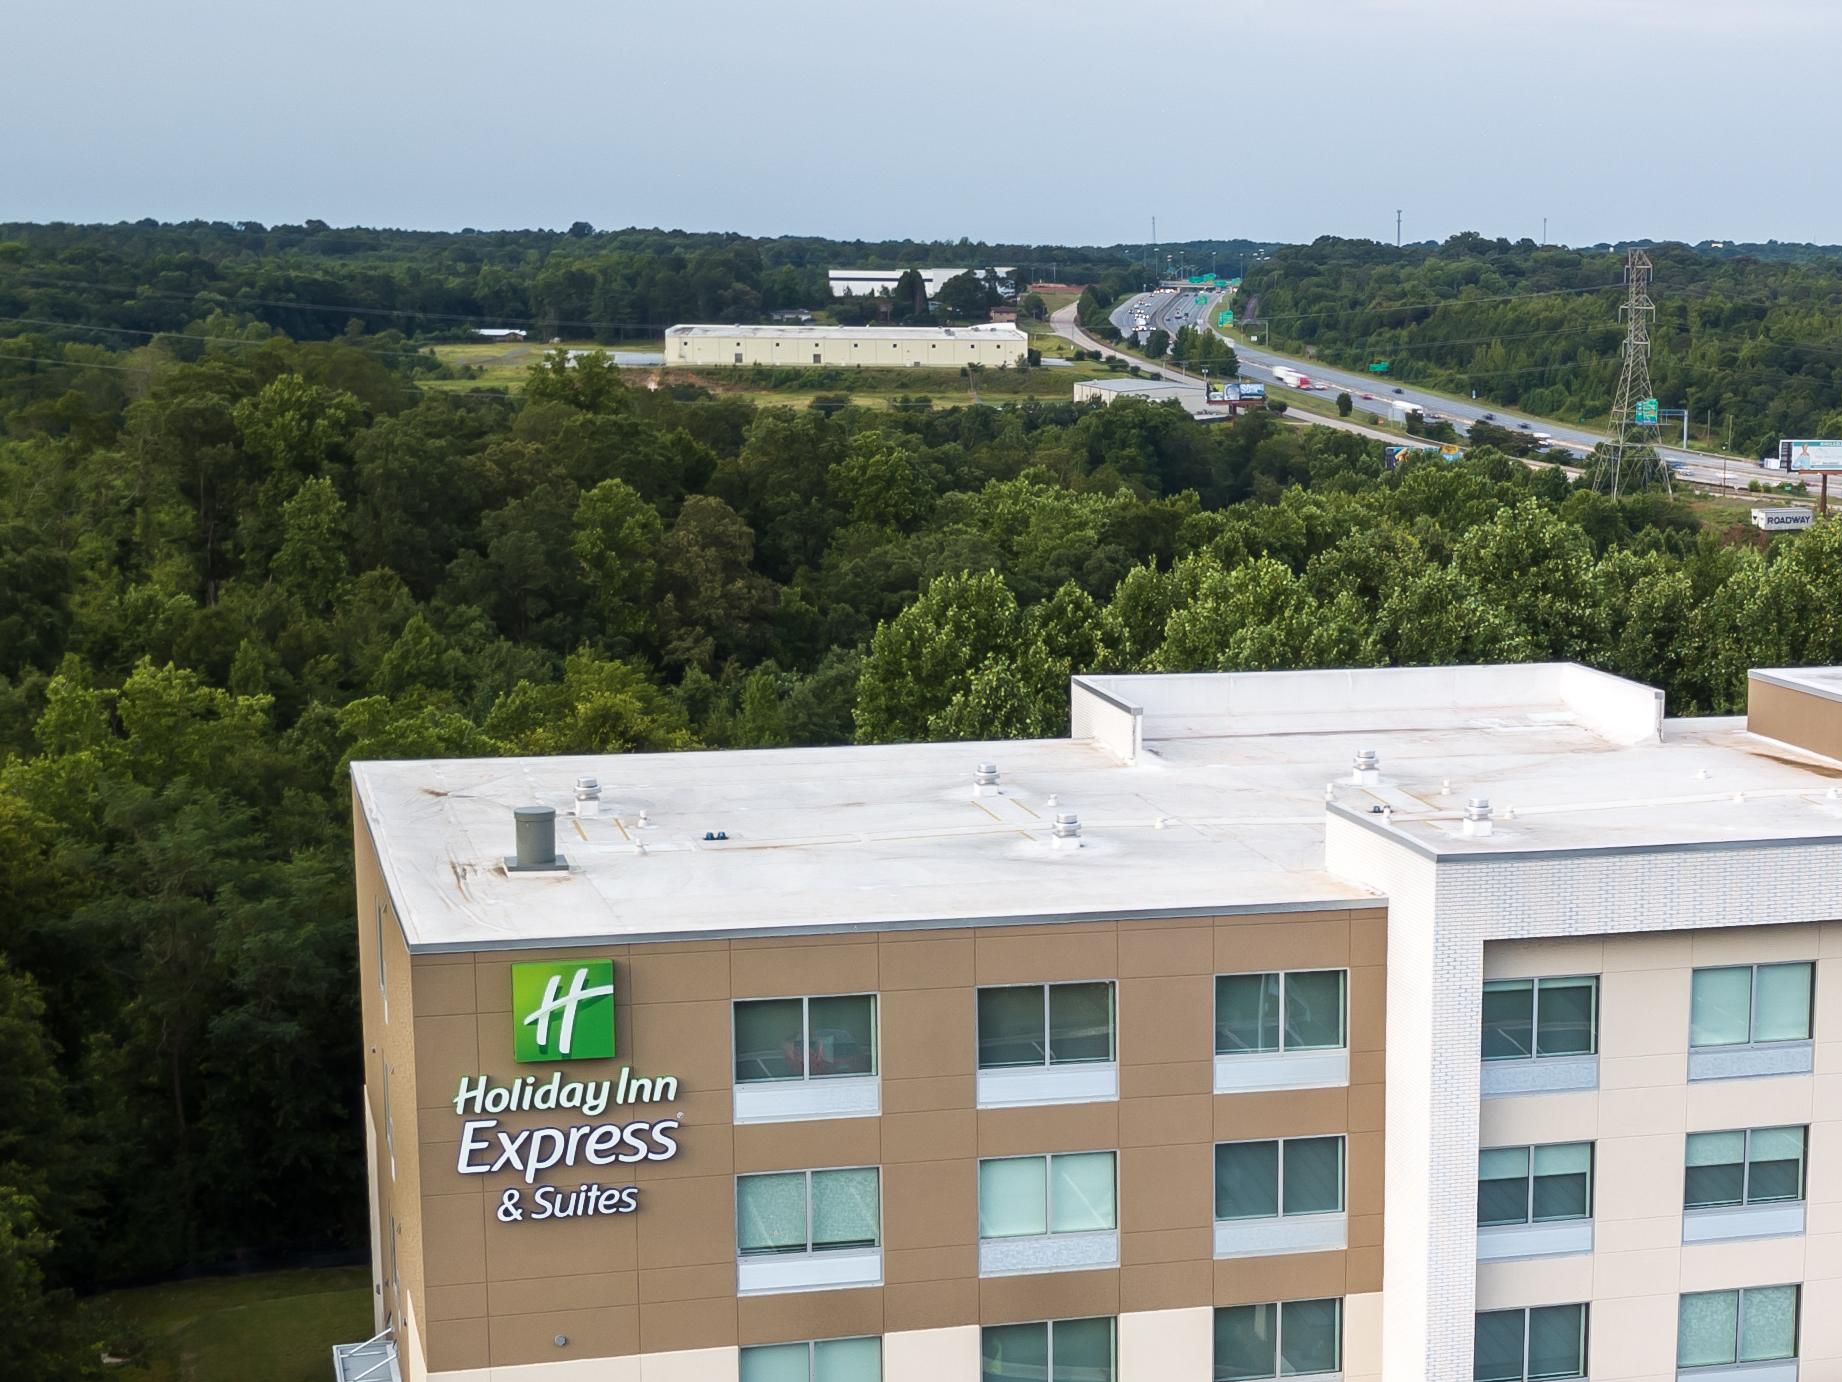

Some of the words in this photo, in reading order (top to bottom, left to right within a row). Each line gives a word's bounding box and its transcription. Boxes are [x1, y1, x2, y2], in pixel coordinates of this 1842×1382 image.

[1767, 515, 1811, 525] ROADWAY
[453, 1071, 611, 1116] Holiday
[616, 1067, 678, 1105] Inn
[457, 1119, 679, 1184] Express
[497, 1189, 523, 1222] &
[531, 1184, 639, 1220] Suites
